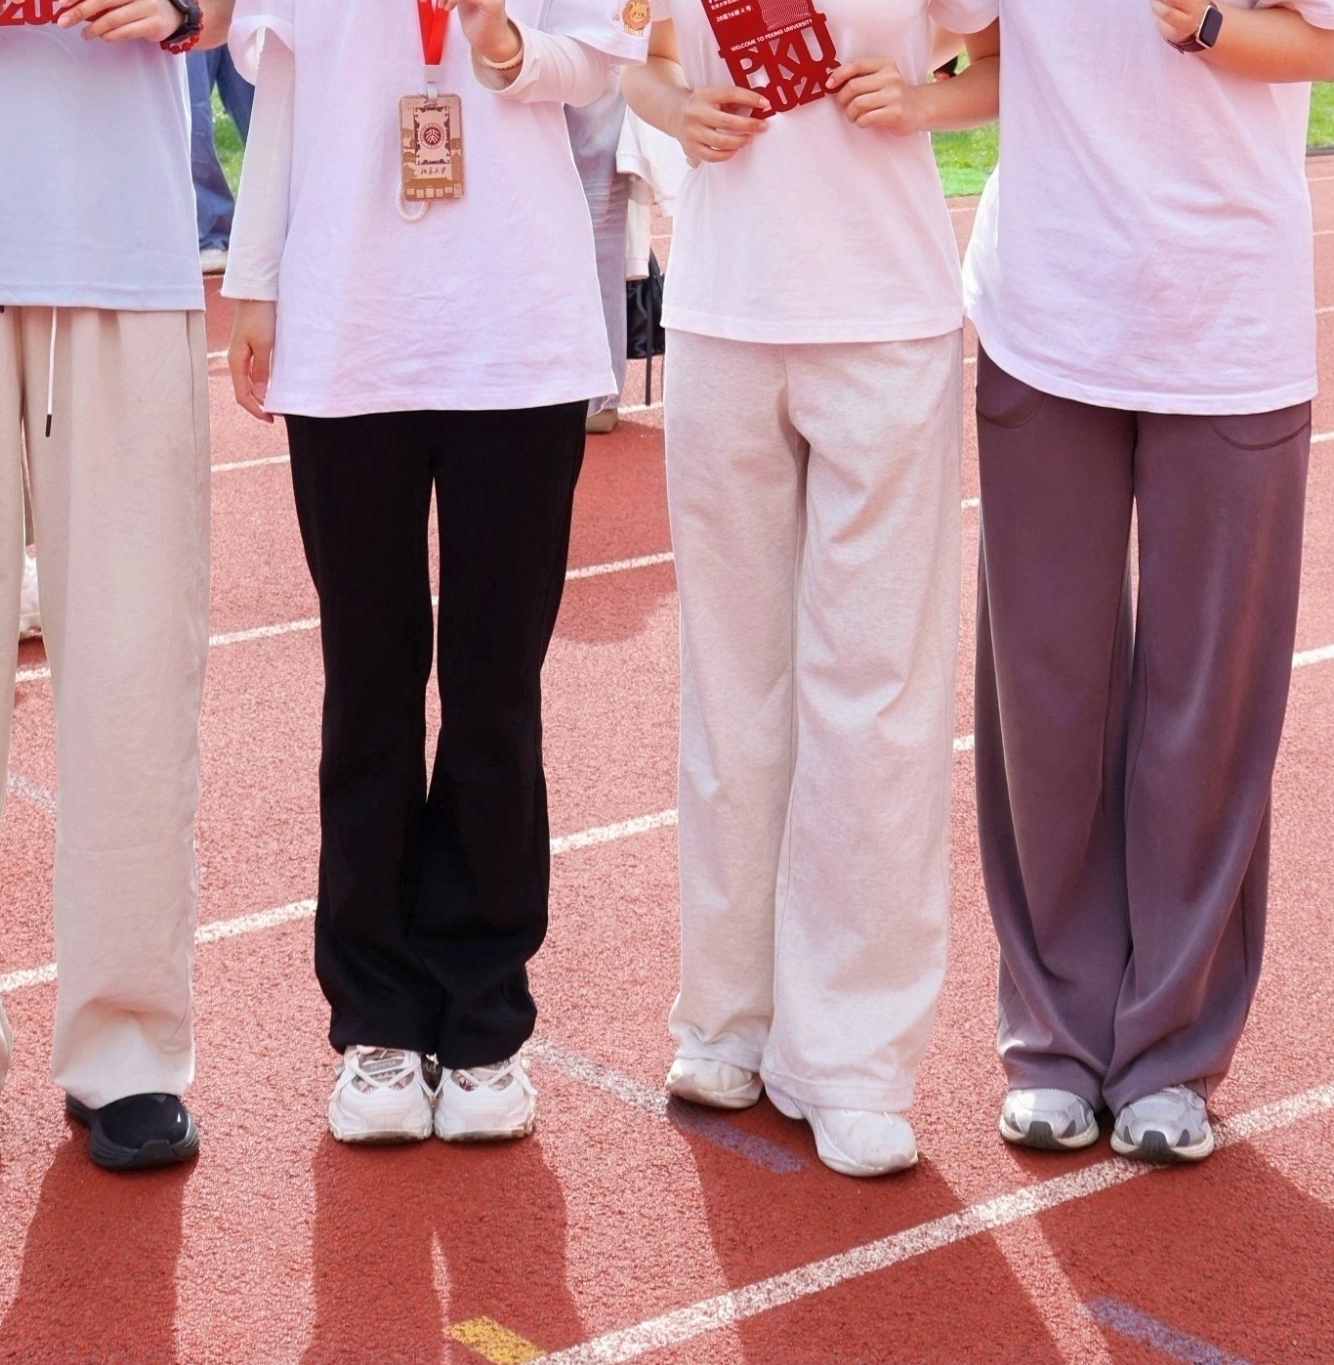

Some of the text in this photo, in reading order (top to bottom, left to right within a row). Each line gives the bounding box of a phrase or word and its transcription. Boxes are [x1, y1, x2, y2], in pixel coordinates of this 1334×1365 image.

[730, 38, 756, 51] WELCOME
[763, 28, 784, 39] PEKING
[782, 18, 812, 33] UNIVERSITY
